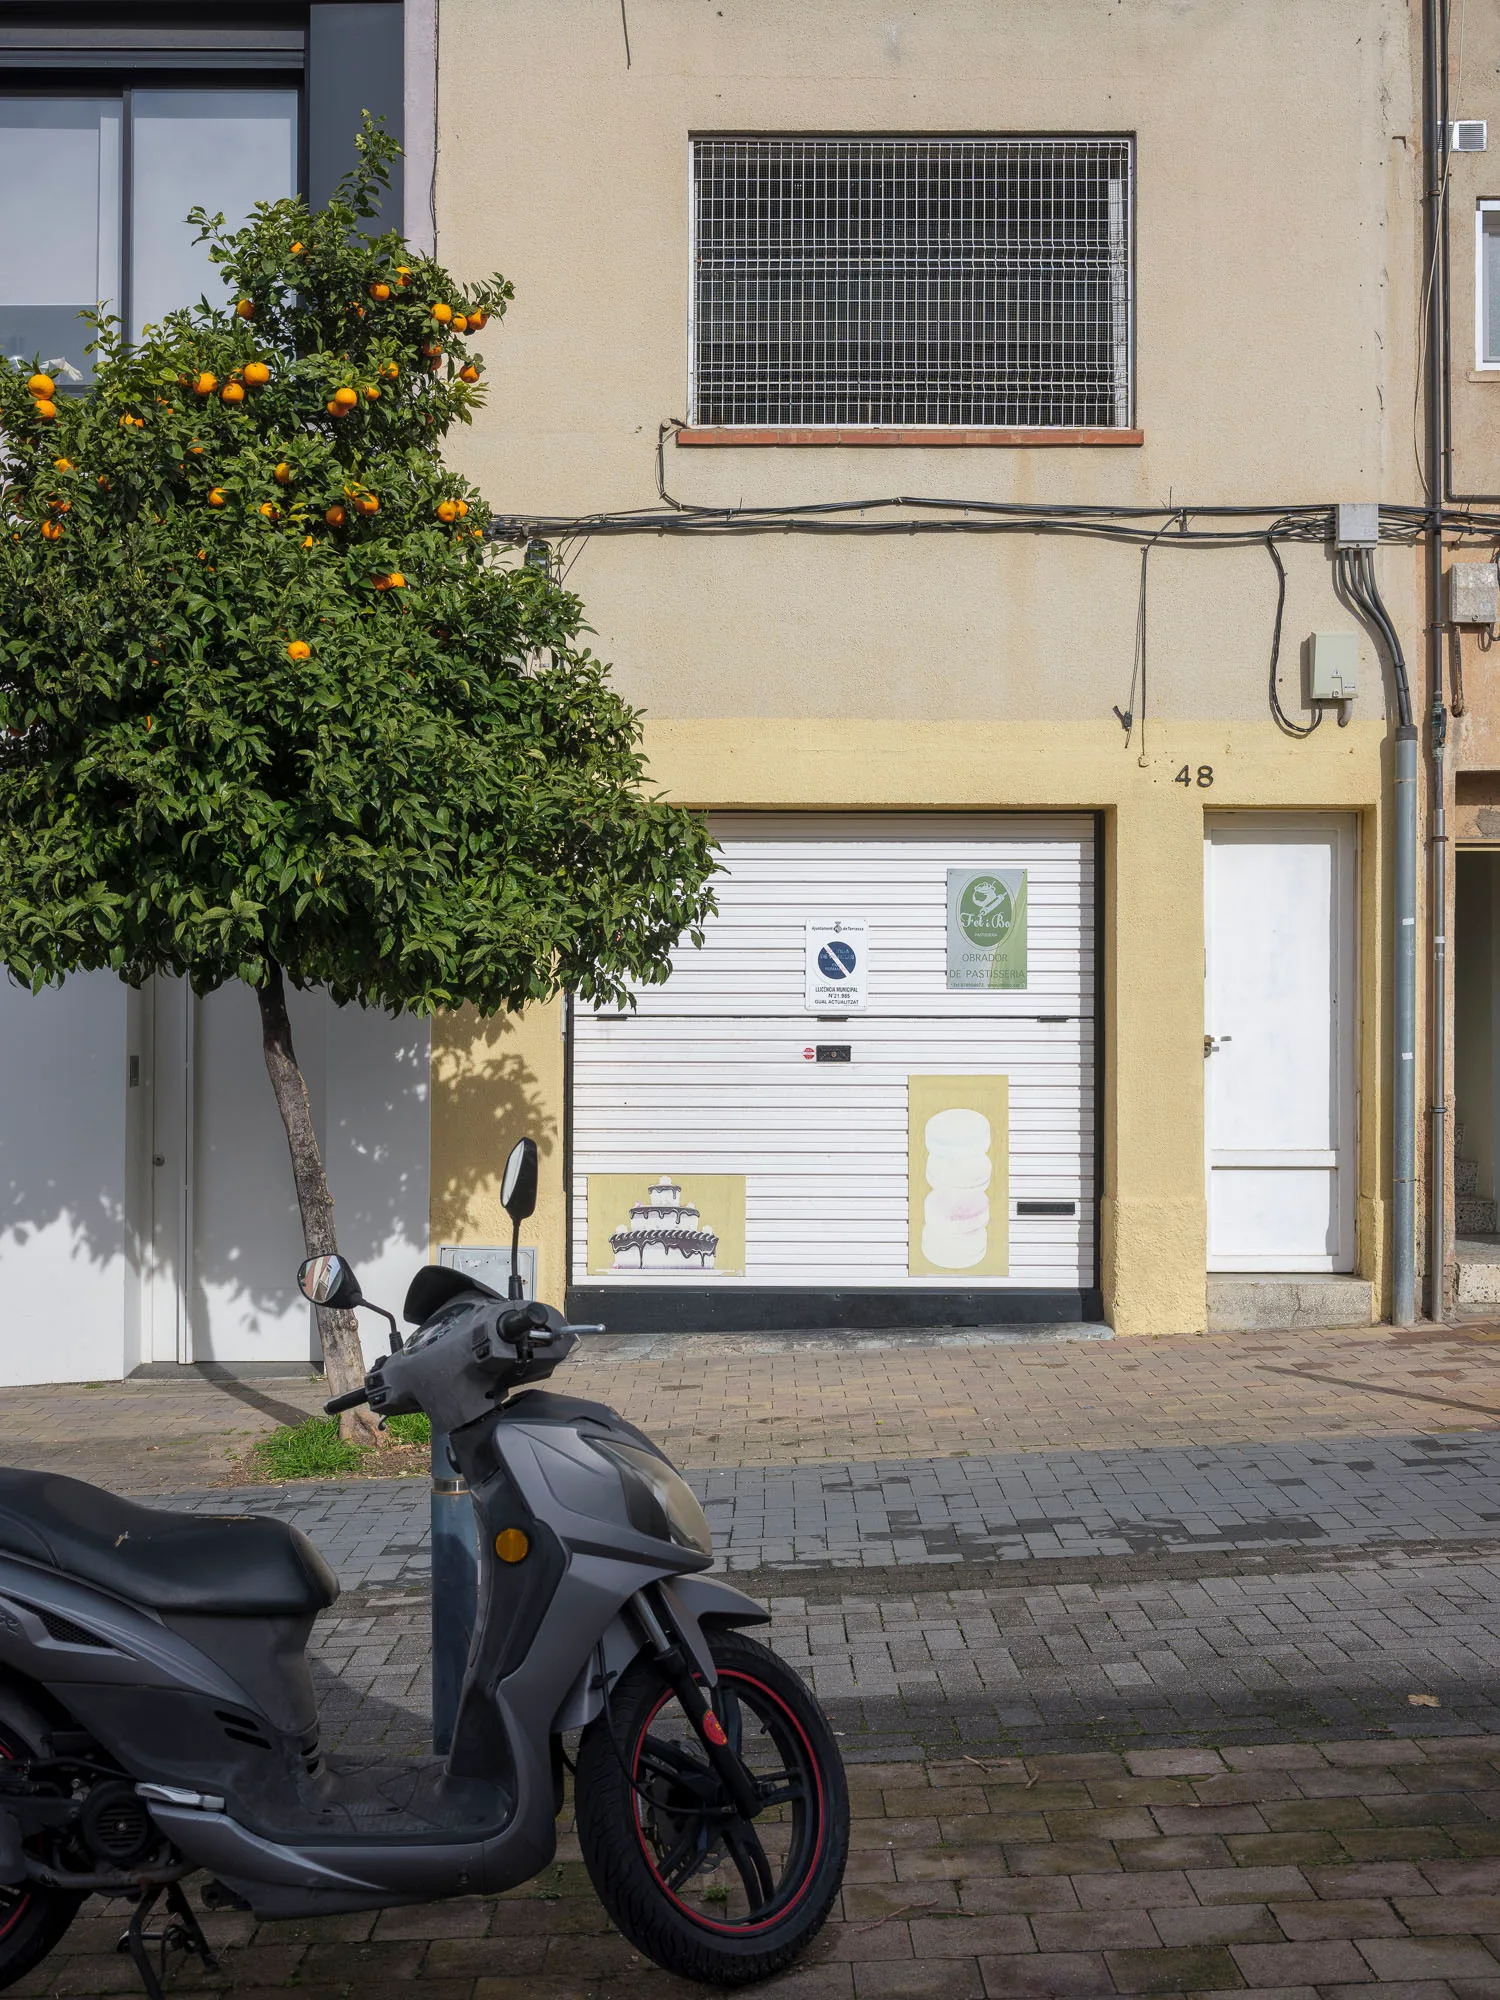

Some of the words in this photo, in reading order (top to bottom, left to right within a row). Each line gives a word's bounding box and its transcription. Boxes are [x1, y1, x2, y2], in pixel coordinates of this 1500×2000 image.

[1174, 764, 1214, 788] 48
[960, 912, 984, 928] Fet
[985, 918, 990, 928] i
[962, 953, 1008, 962] OBRADOR
[949, 969, 961, 979] DE
[966, 969, 1025, 979] PASTISSERIA
